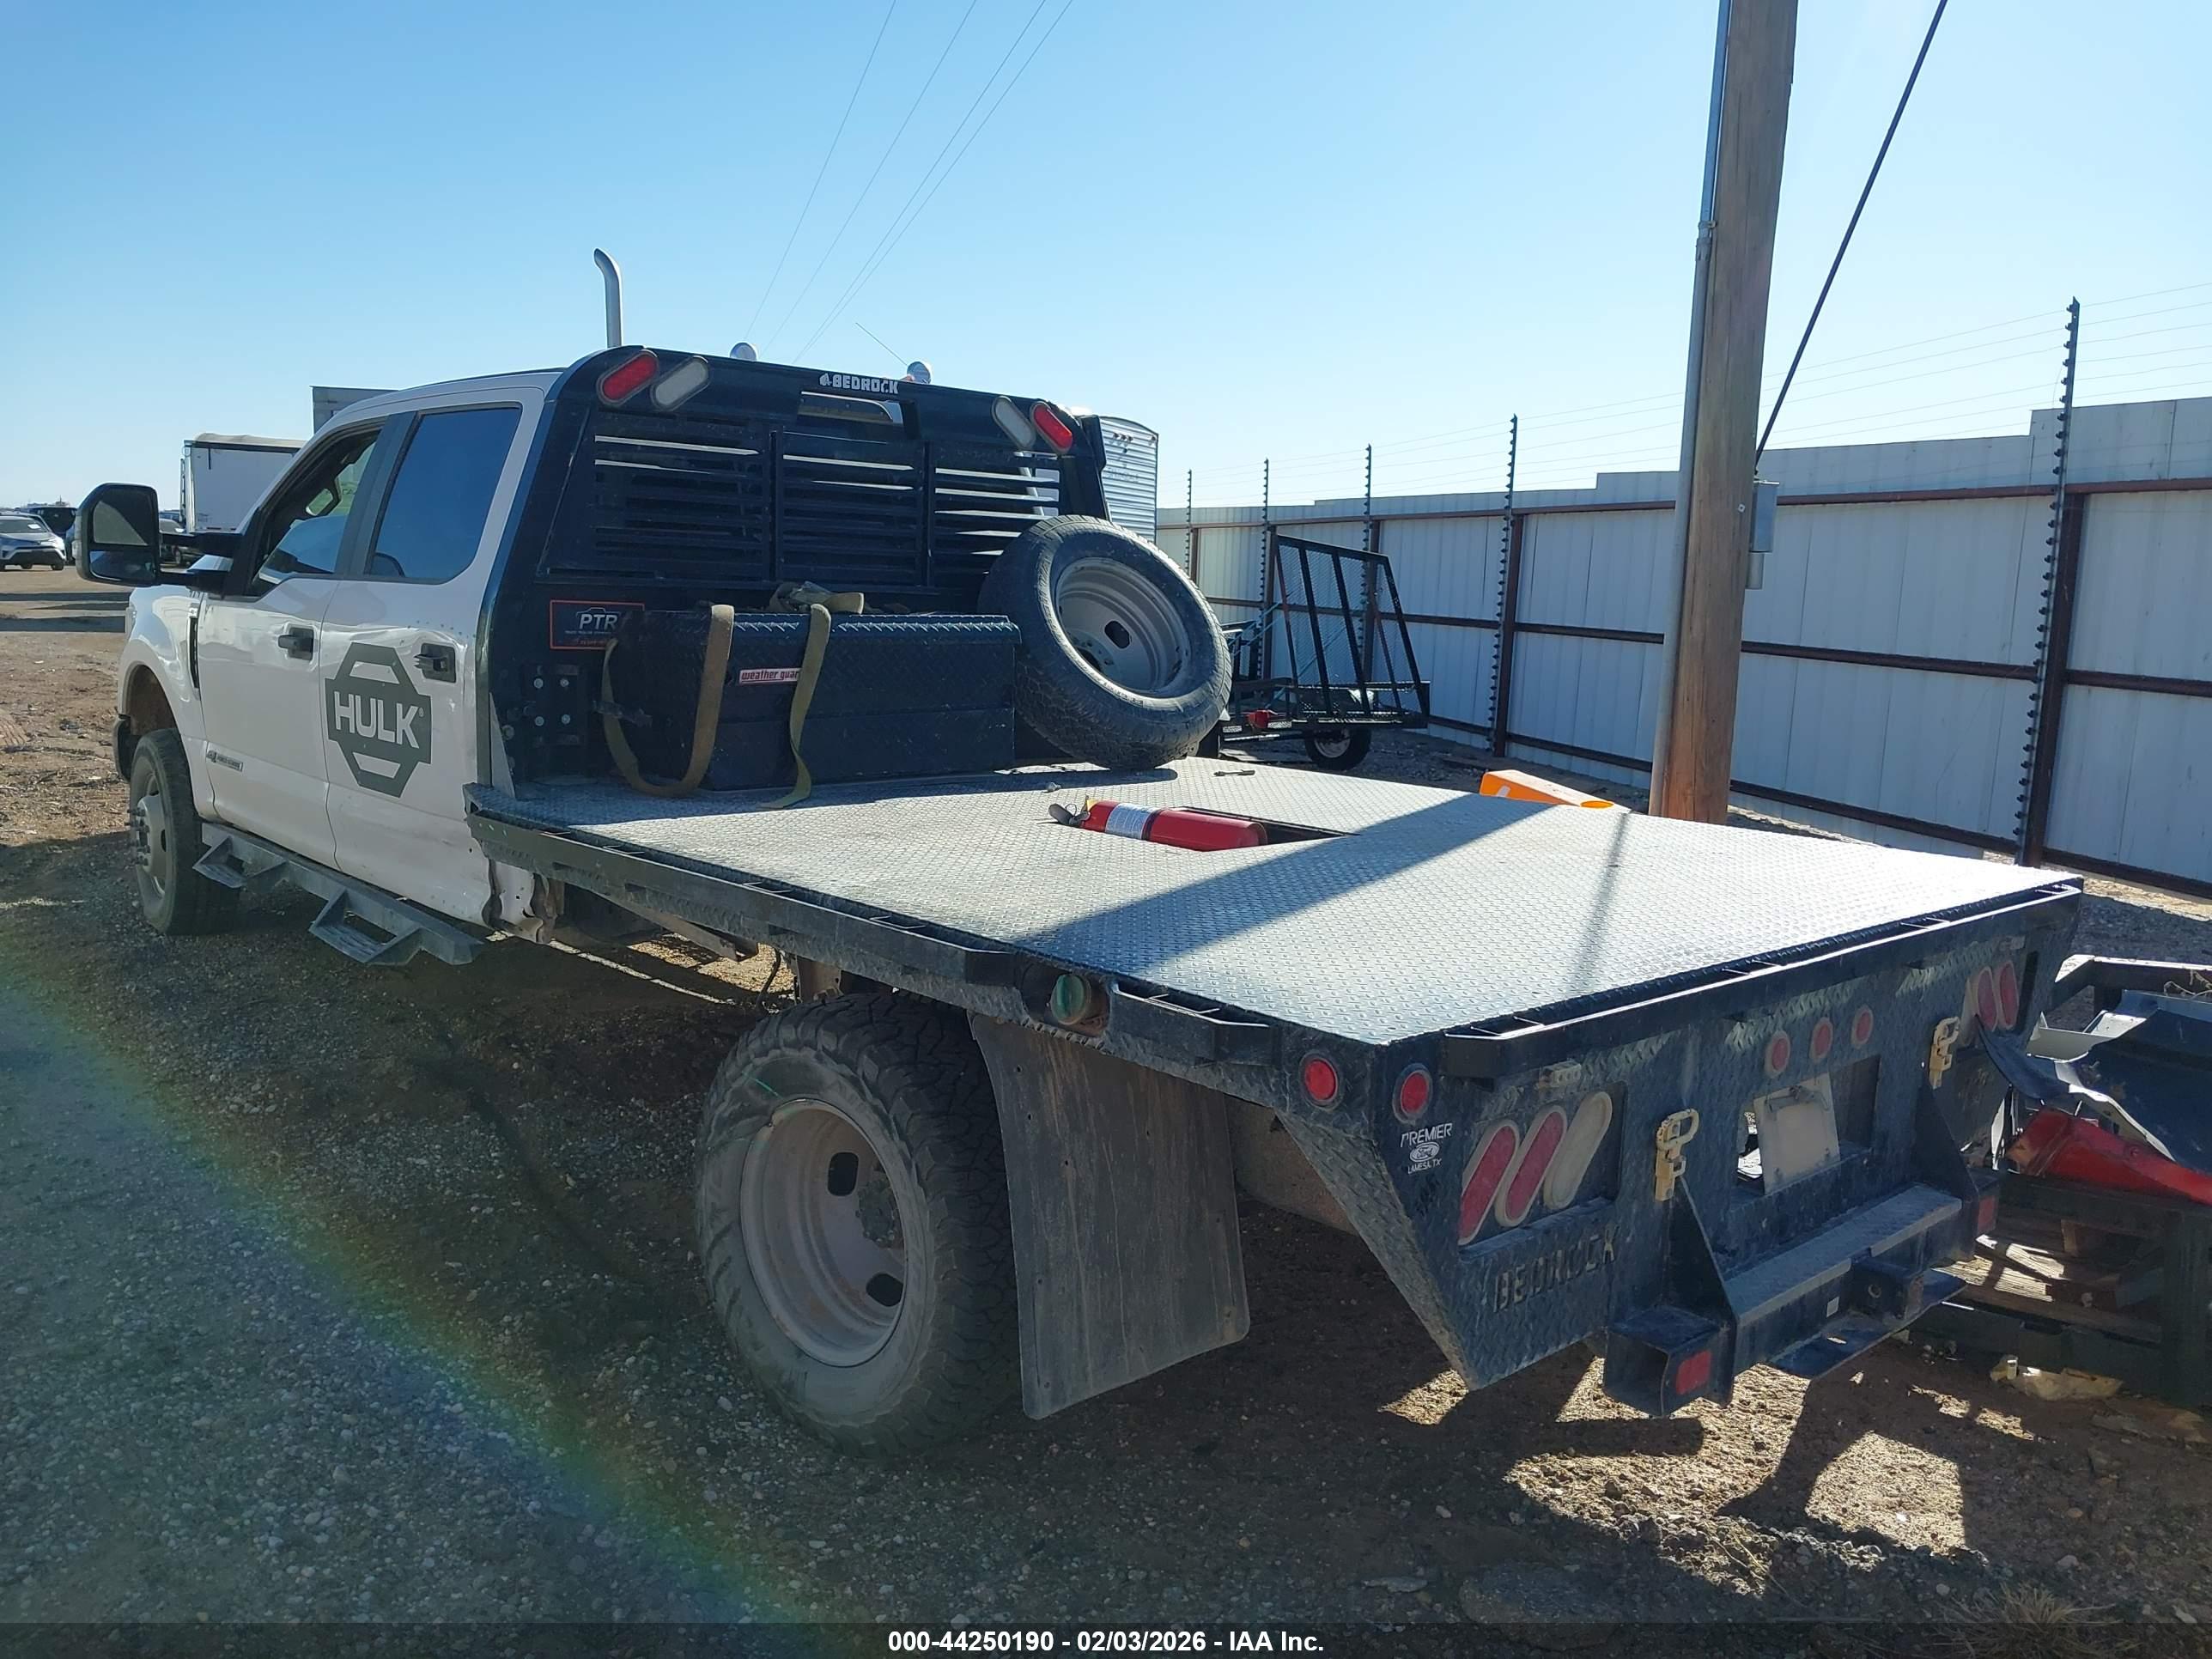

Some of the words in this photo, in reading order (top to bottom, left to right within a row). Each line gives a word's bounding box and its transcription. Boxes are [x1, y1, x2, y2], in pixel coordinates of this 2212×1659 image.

[833, 374, 899, 394] BEDROCK
[579, 613, 618, 630] PTR
[741, 670, 779, 680] weather
[780, 671, 798, 680] guar
[333, 690, 420, 749] HULK
[1400, 1122, 1453, 1148] PREMIER
[1432, 1158, 1443, 1169] TX
